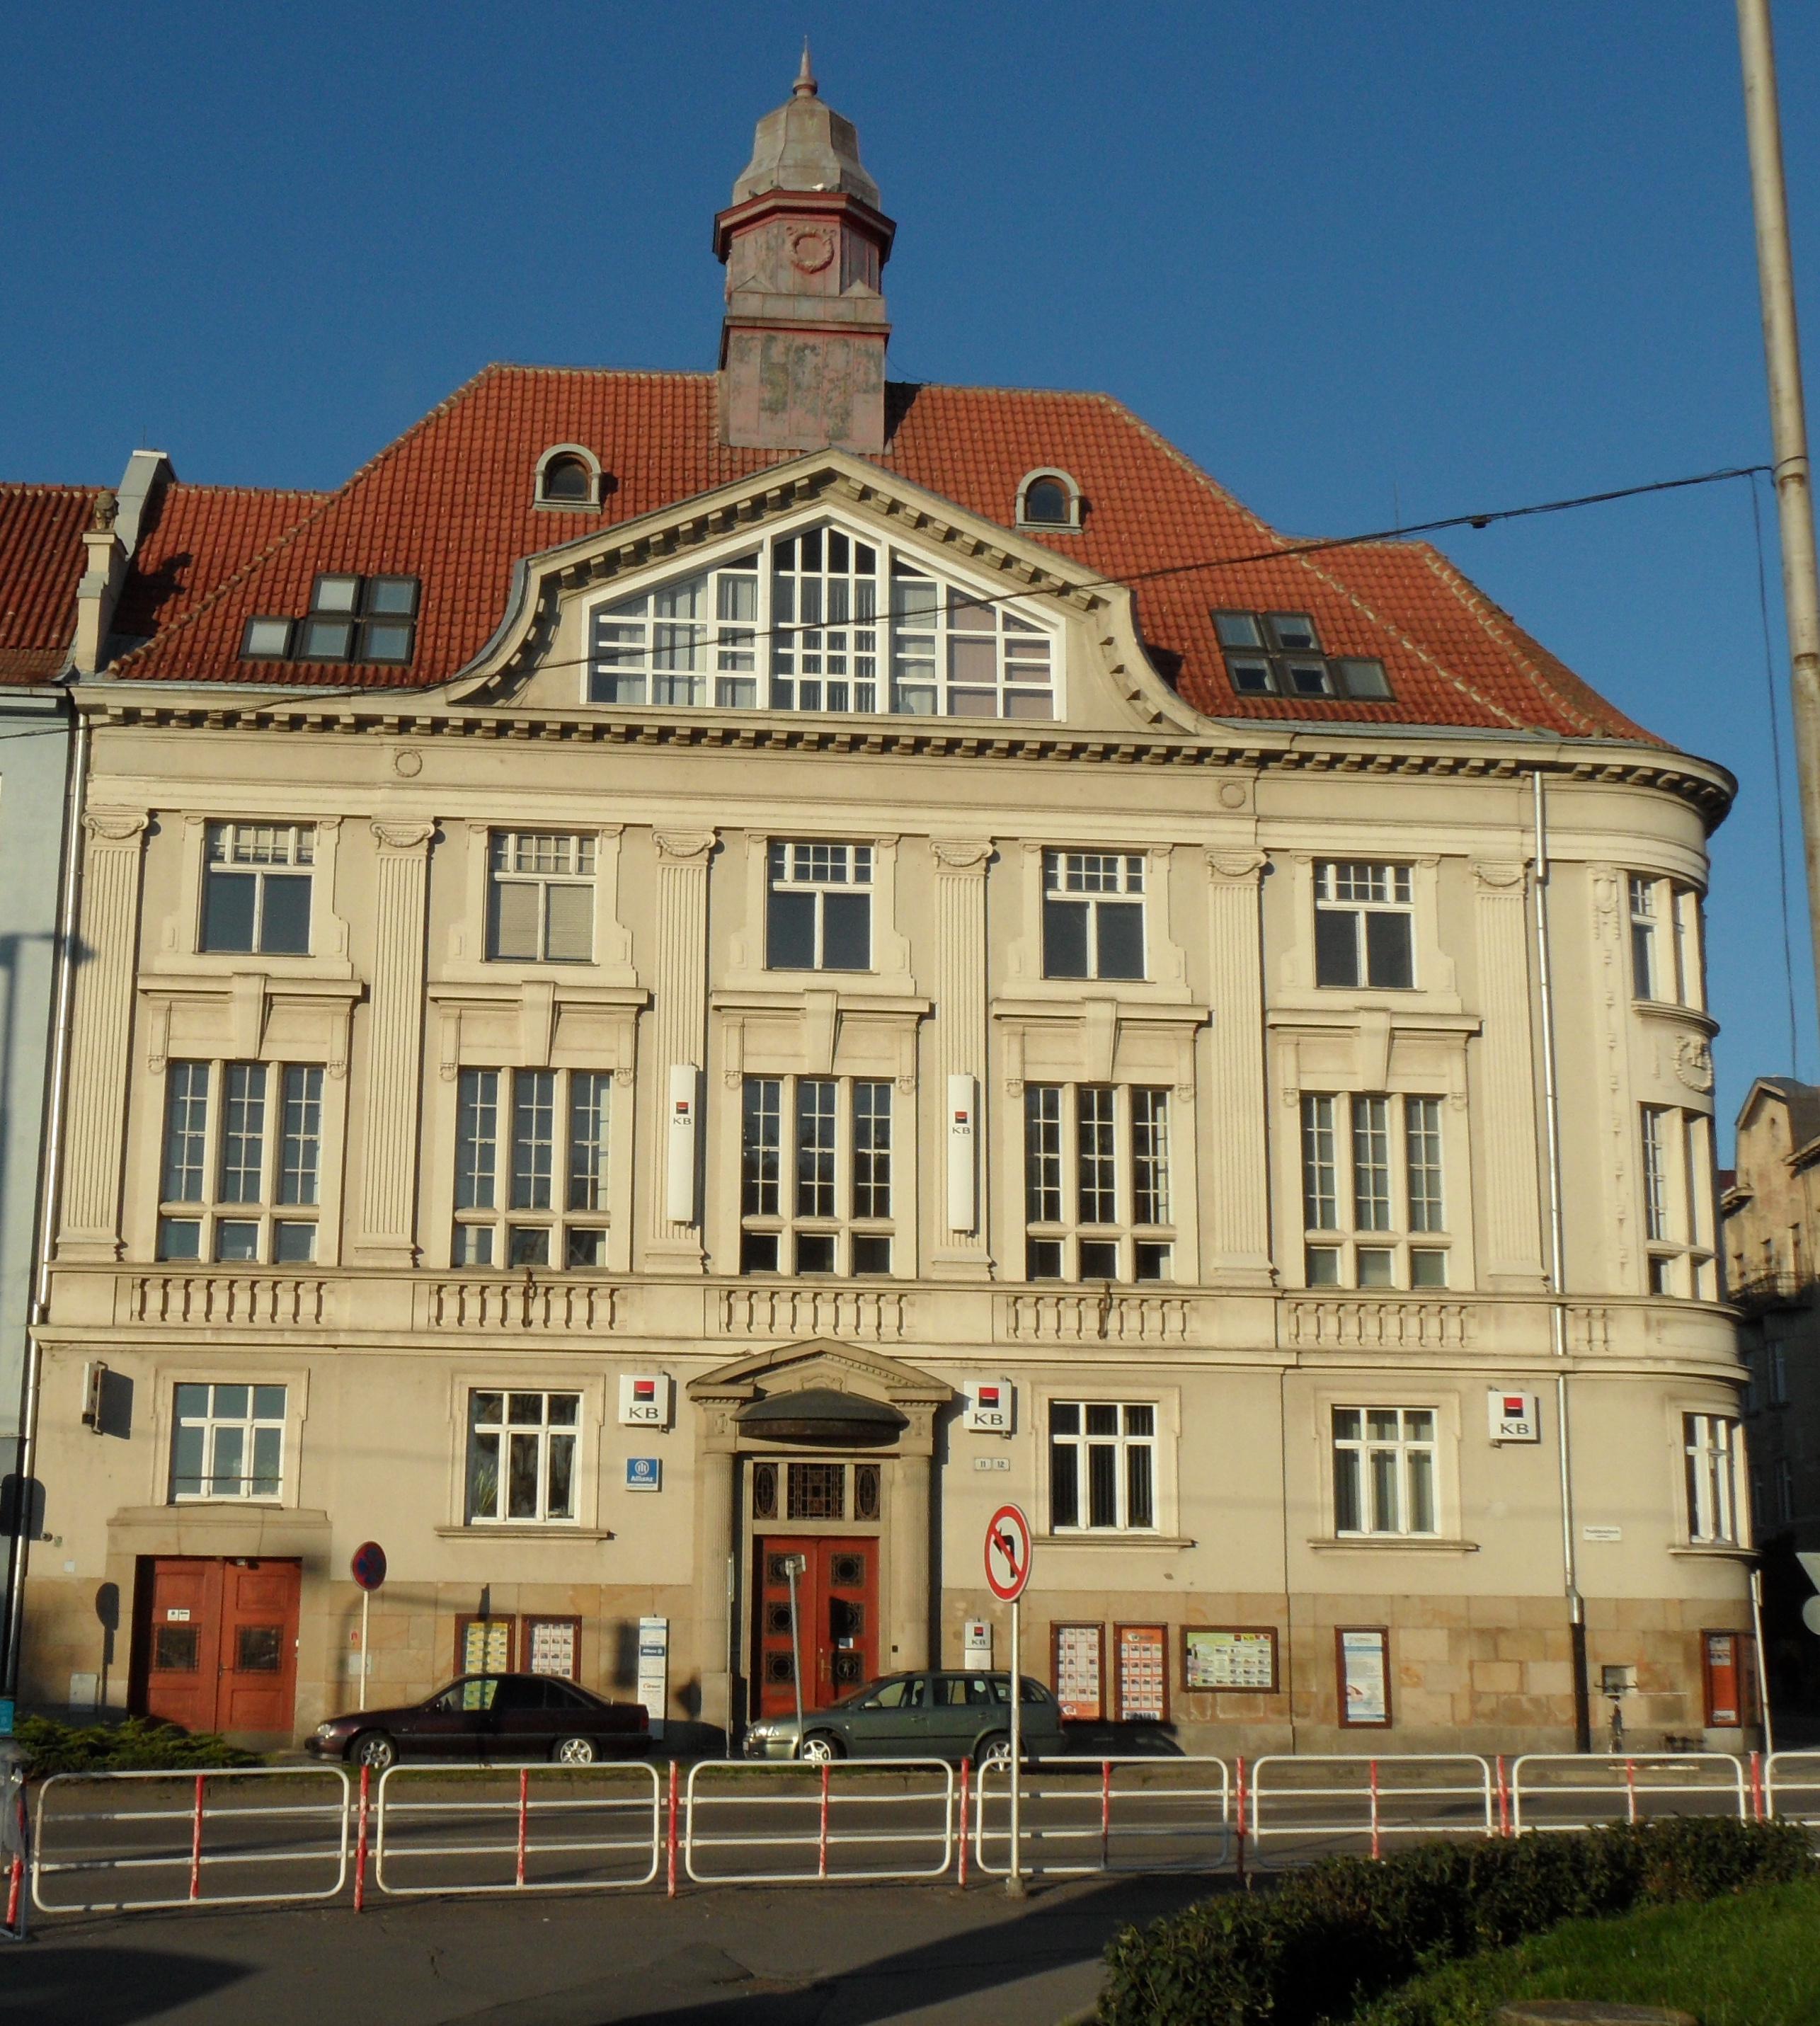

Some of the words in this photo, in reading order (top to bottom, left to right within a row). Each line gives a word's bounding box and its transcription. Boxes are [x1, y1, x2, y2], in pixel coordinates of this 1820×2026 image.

[629, 1407, 658, 1419] KB
[974, 1413, 1003, 1425] KB
[1500, 1423, 1529, 1435] KB
